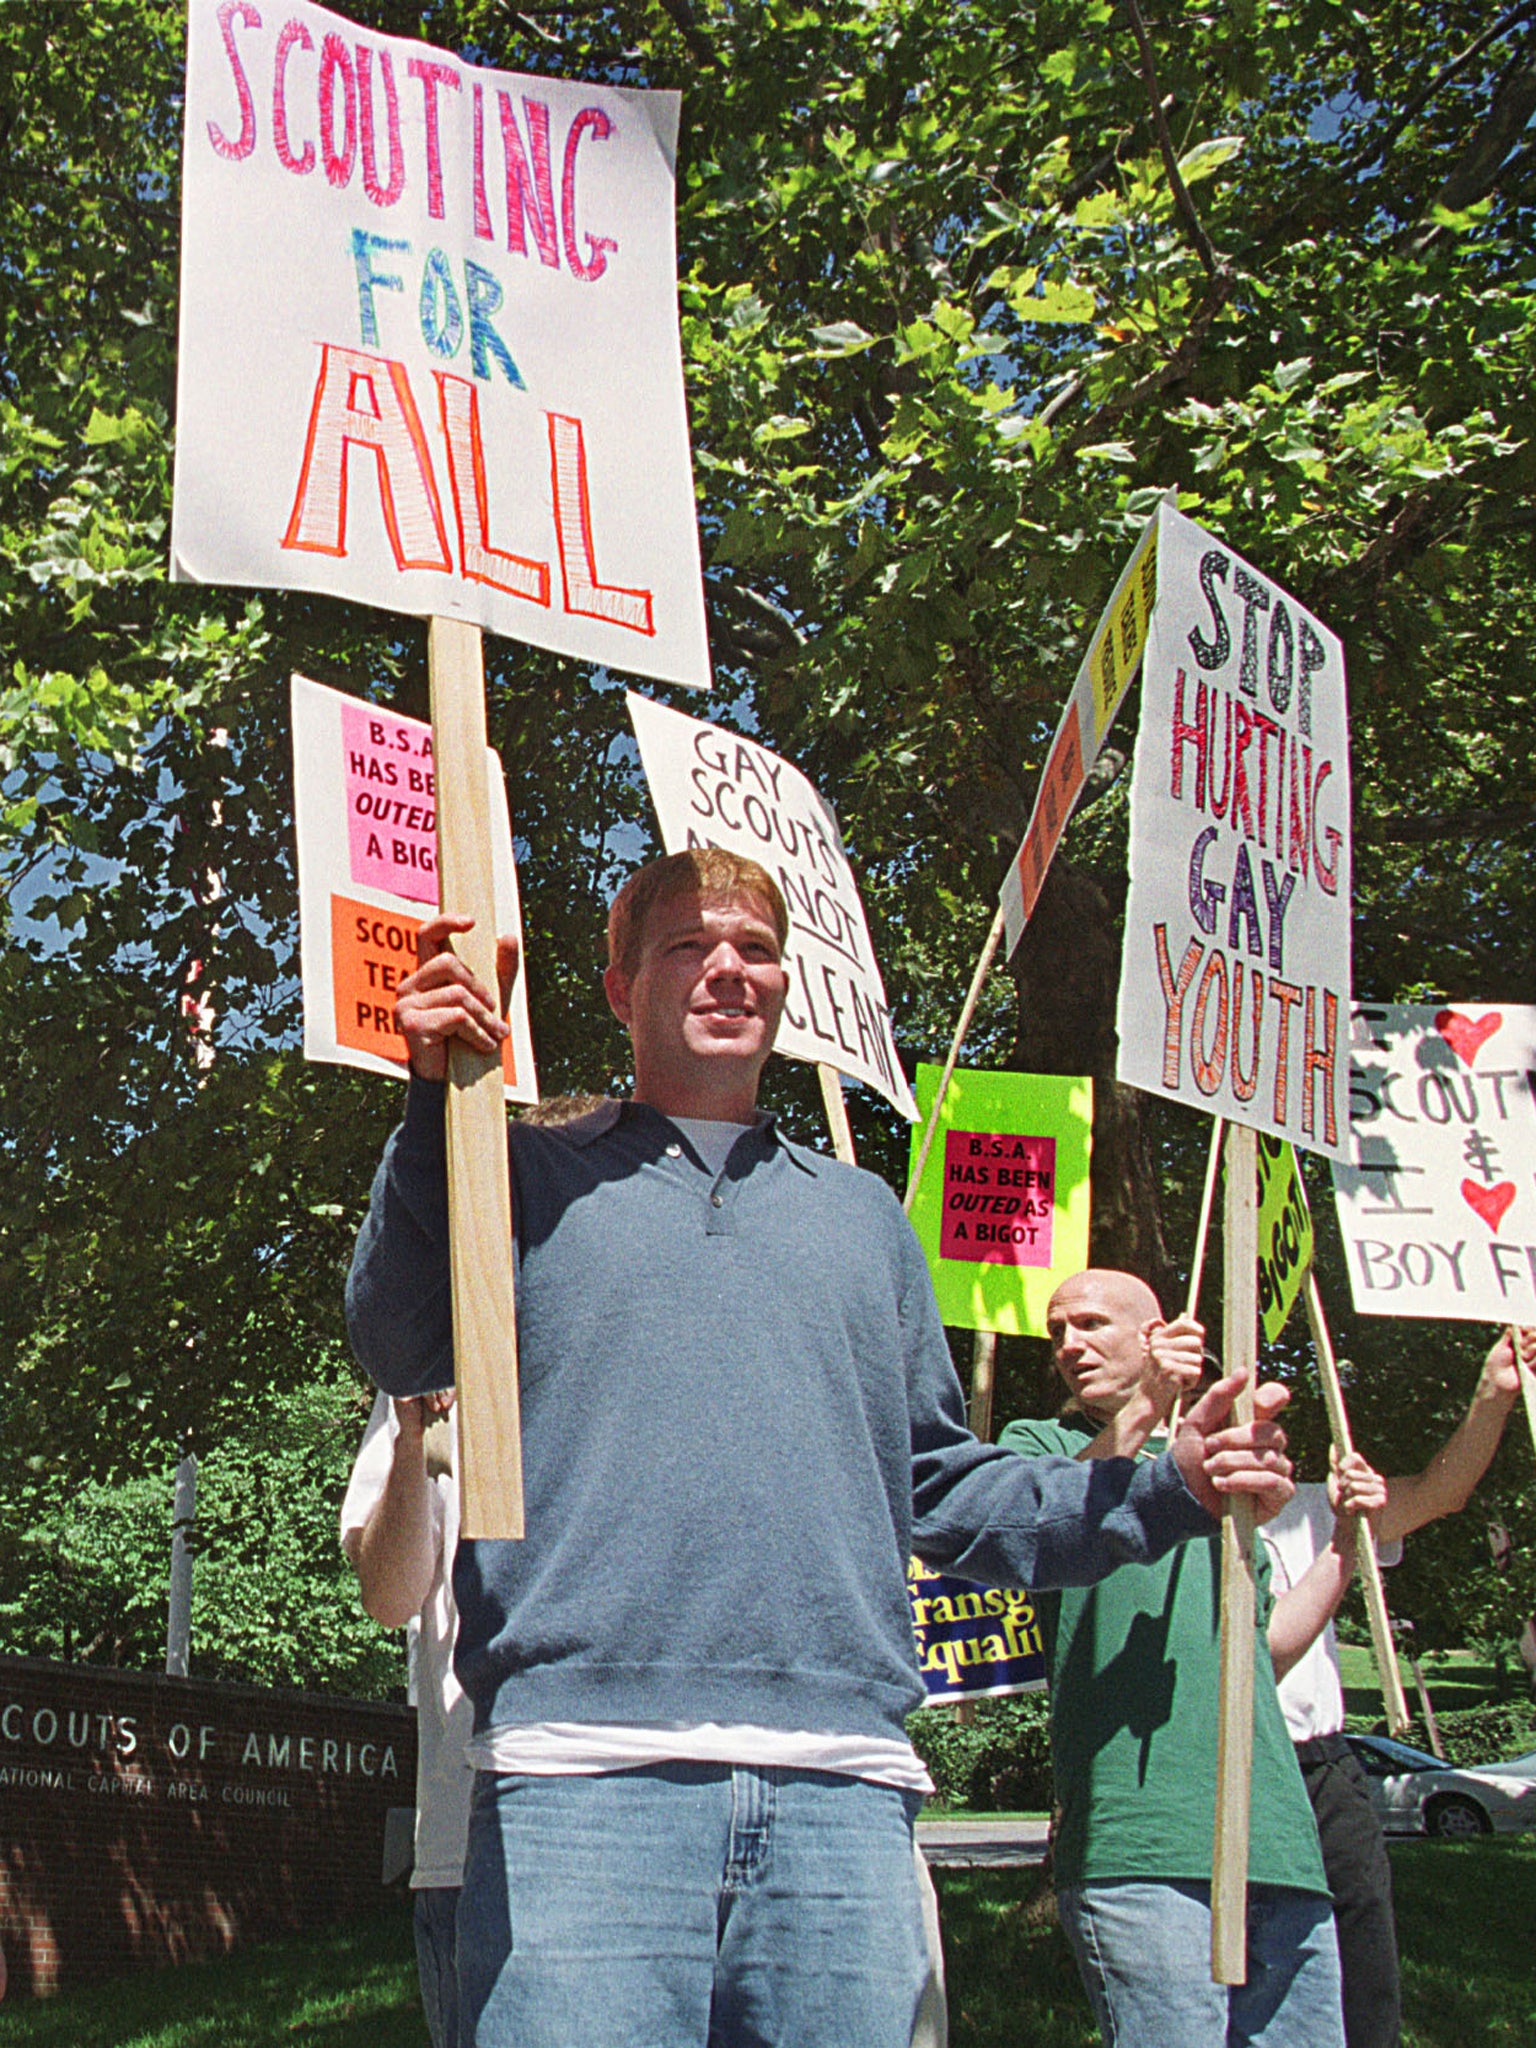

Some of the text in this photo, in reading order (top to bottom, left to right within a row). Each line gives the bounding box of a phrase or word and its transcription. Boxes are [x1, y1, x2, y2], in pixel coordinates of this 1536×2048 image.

[206, 1, 618, 282] SCOUTING
[347, 227, 527, 391] FOR
[279, 342, 655, 637] ALL
[1188, 549, 1325, 737] STOP
[350, 751, 399, 786] HAS
[694, 730, 782, 801] GAY
[1170, 667, 1343, 897] HURTING
[355, 792, 436, 833] OUTED
[691, 768, 837, 889] SCOUTS
[366, 832, 438, 872] A BIG
[778, 865, 861, 960] NOT
[1188, 825, 1296, 975] GAY
[1153, 923, 1339, 1146] YOUTH
[950, 1163, 1051, 1190] HAS BEEN
[969, 1138, 1032, 1161] B.S.A.
[949, 1192, 1049, 1218] OUTED AS
[1359, 1163, 1434, 1215] I
[954, 1222, 1039, 1246] A BIGOT
[1354, 1238, 1536, 1298] BOY F
[907, 1587, 1035, 1626] ransg
[2, 1704, 398, 1778] COUTS OF AMERICA
[167, 1782, 208, 1800] AREA
[222, 1786, 291, 1808] COUNCIL
